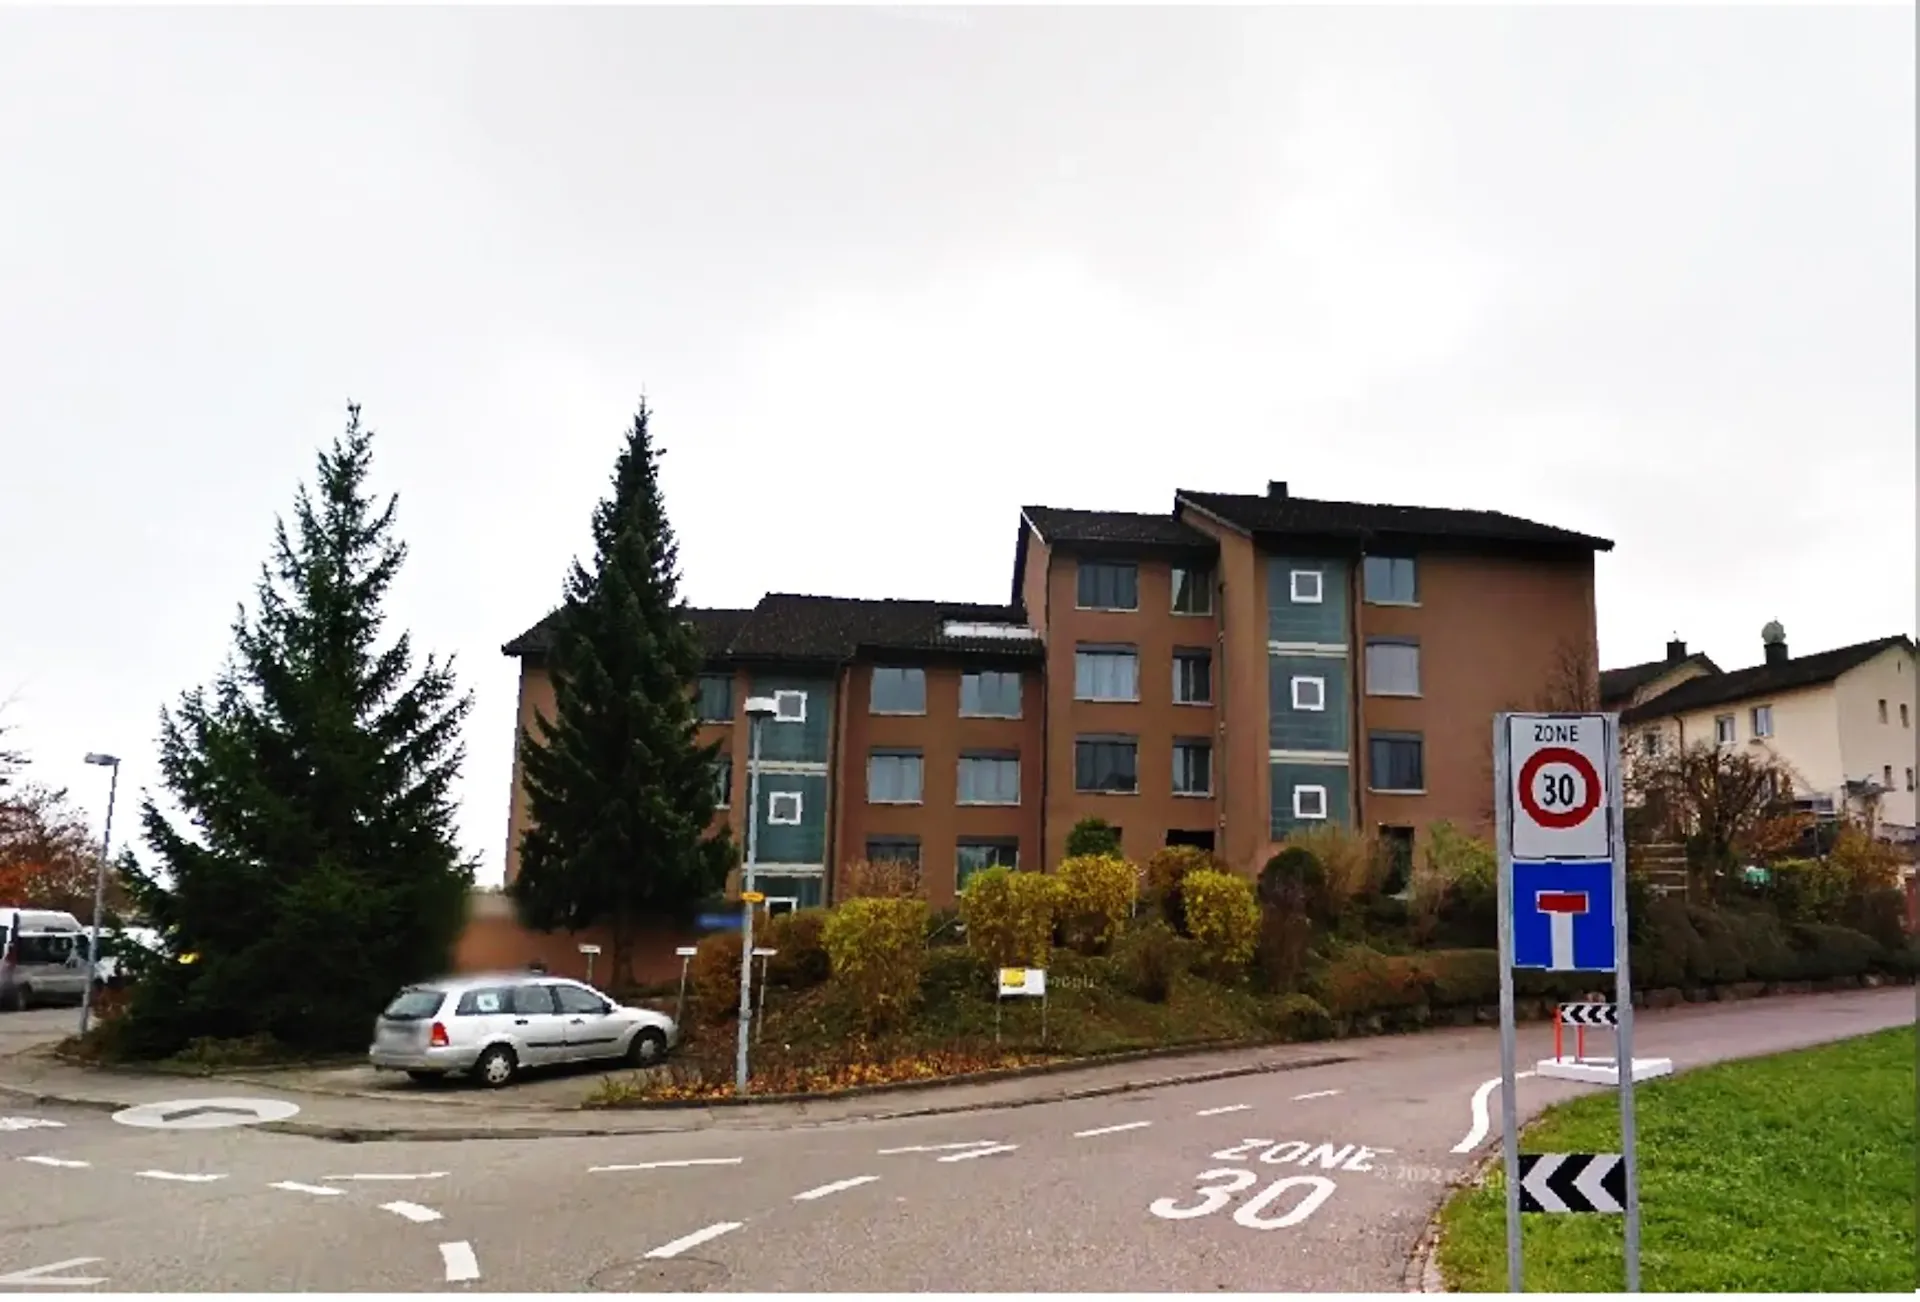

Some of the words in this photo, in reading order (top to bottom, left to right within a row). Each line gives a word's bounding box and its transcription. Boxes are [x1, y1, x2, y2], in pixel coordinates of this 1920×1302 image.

[1534, 725, 1579, 742] ZONE
[1543, 773, 1575, 806] 30
[1211, 1137, 1395, 1172] ZONE
[1150, 1167, 1338, 1230] 30
